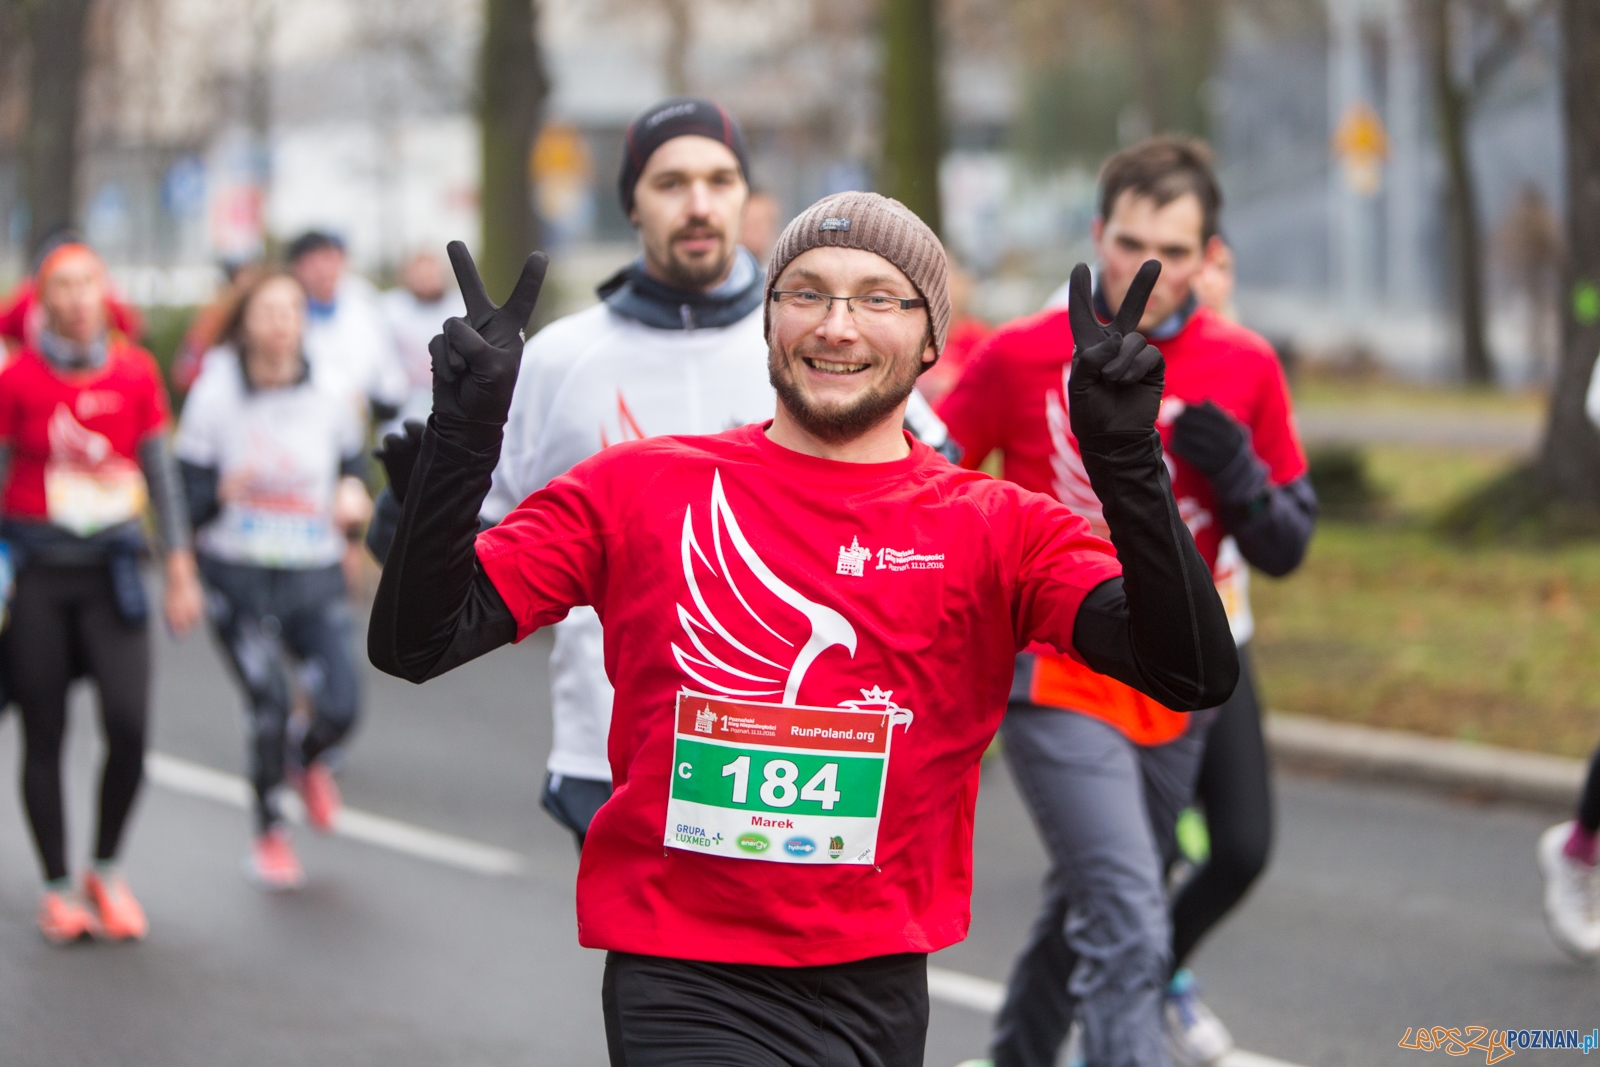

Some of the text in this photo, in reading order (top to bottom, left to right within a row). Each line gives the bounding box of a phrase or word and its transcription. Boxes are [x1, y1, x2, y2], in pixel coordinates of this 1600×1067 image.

[876, 547, 887, 570] 1
[720, 715, 729, 732] 1
[790, 725, 875, 743] RunPoland.org
[678, 762, 693, 779] C
[721, 755, 841, 811] 184
[676, 824, 706, 837] GRUPA
[751, 816, 794, 829] Marek
[675, 833, 711, 847] LUXMED
[741, 840, 768, 850] energy
